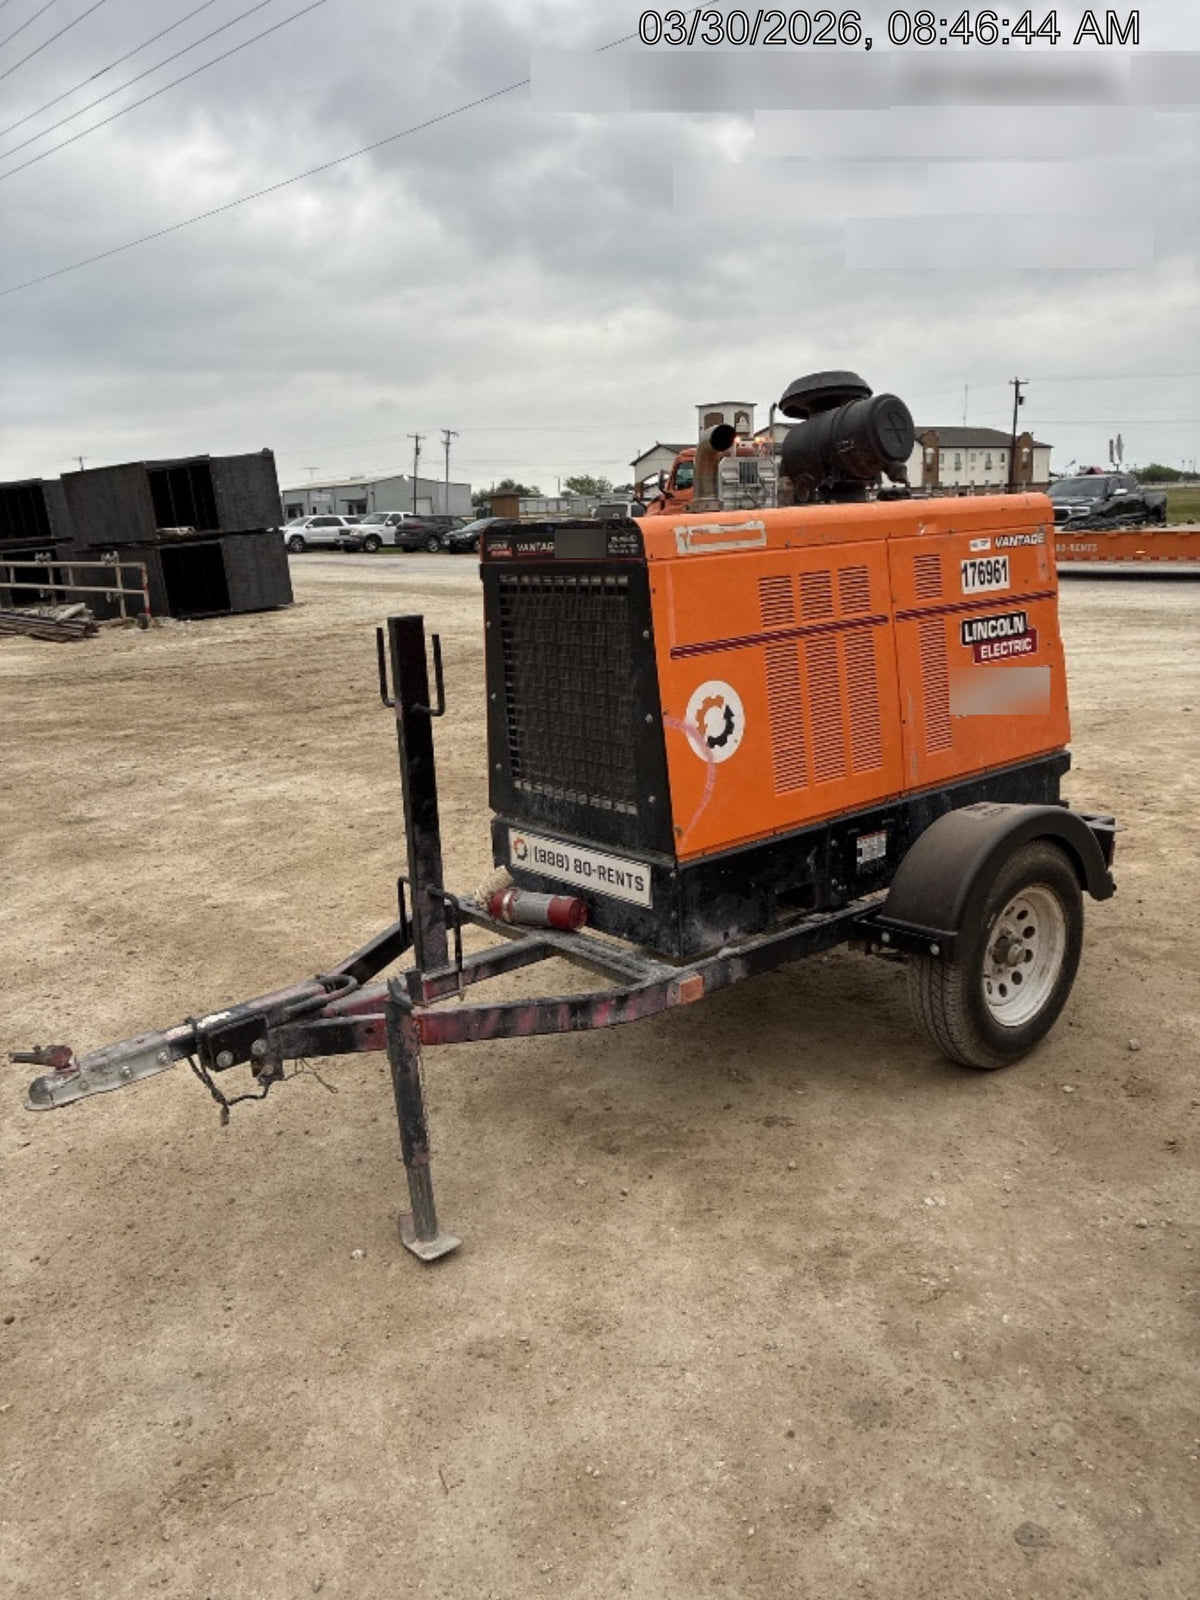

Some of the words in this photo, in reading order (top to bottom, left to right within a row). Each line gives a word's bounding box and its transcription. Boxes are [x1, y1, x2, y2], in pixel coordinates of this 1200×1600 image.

[516, 541, 554, 552] VANTAG
[995, 533, 1045, 548] VANTAGE
[962, 558, 1007, 587] 176961
[965, 616, 1024, 642] LINCOLN
[980, 638, 1032, 659] ELECTRIC
[534, 846, 569, 871] (888)
